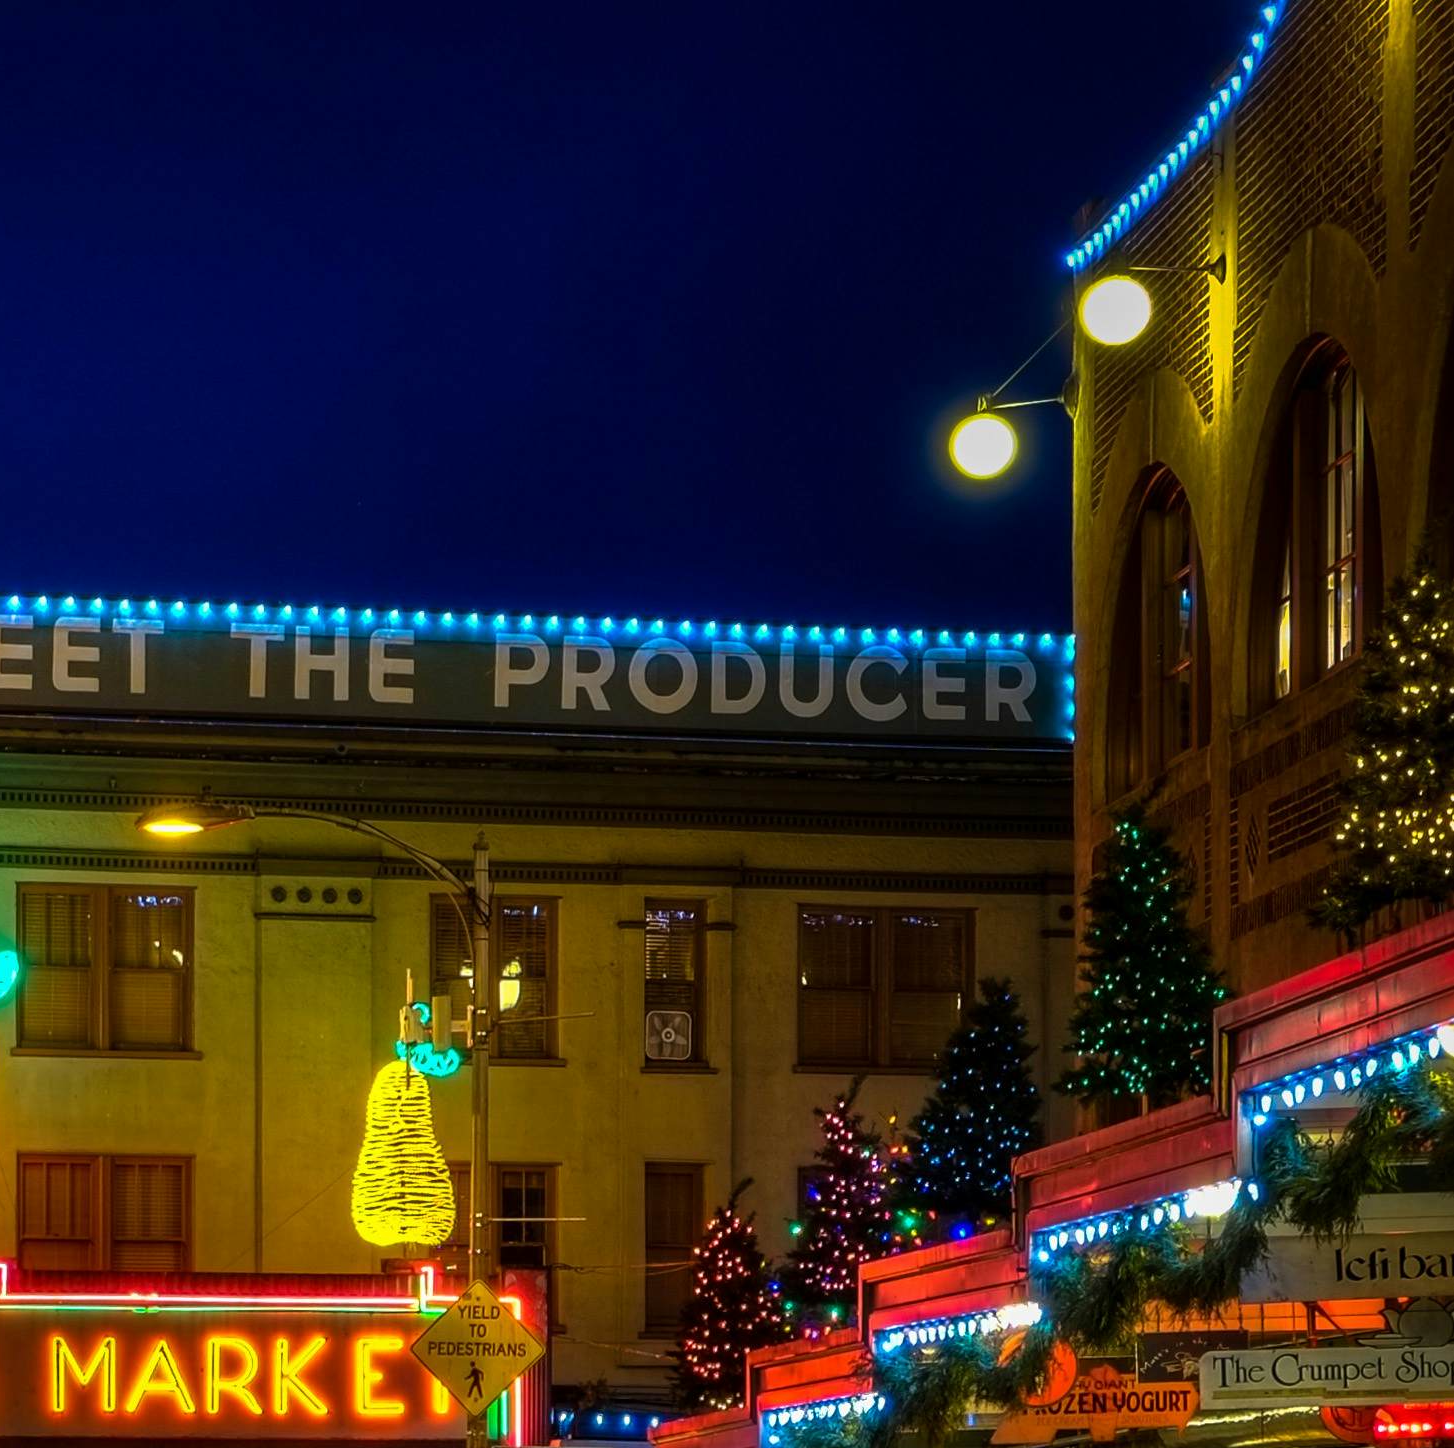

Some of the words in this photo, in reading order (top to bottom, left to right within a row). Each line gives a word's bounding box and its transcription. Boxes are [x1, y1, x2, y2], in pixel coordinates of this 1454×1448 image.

[230, 622, 416, 706] THE
[493, 630, 1038, 723] PRODUCER
[1399, 1246, 1454, 1280] ba
[457, 1305, 501, 1319] YIELD
[468, 1323, 487, 1338] TO
[427, 1341, 527, 1358] PEDESTRIANS
[50, 1334, 451, 1417] MARKE
[1212, 1355, 1265, 1388] The
[1271, 1353, 1387, 1389] Crumpet
[1023, 1391, 1108, 1415] OZEN
[1113, 1390, 1192, 1413] YOGURT
